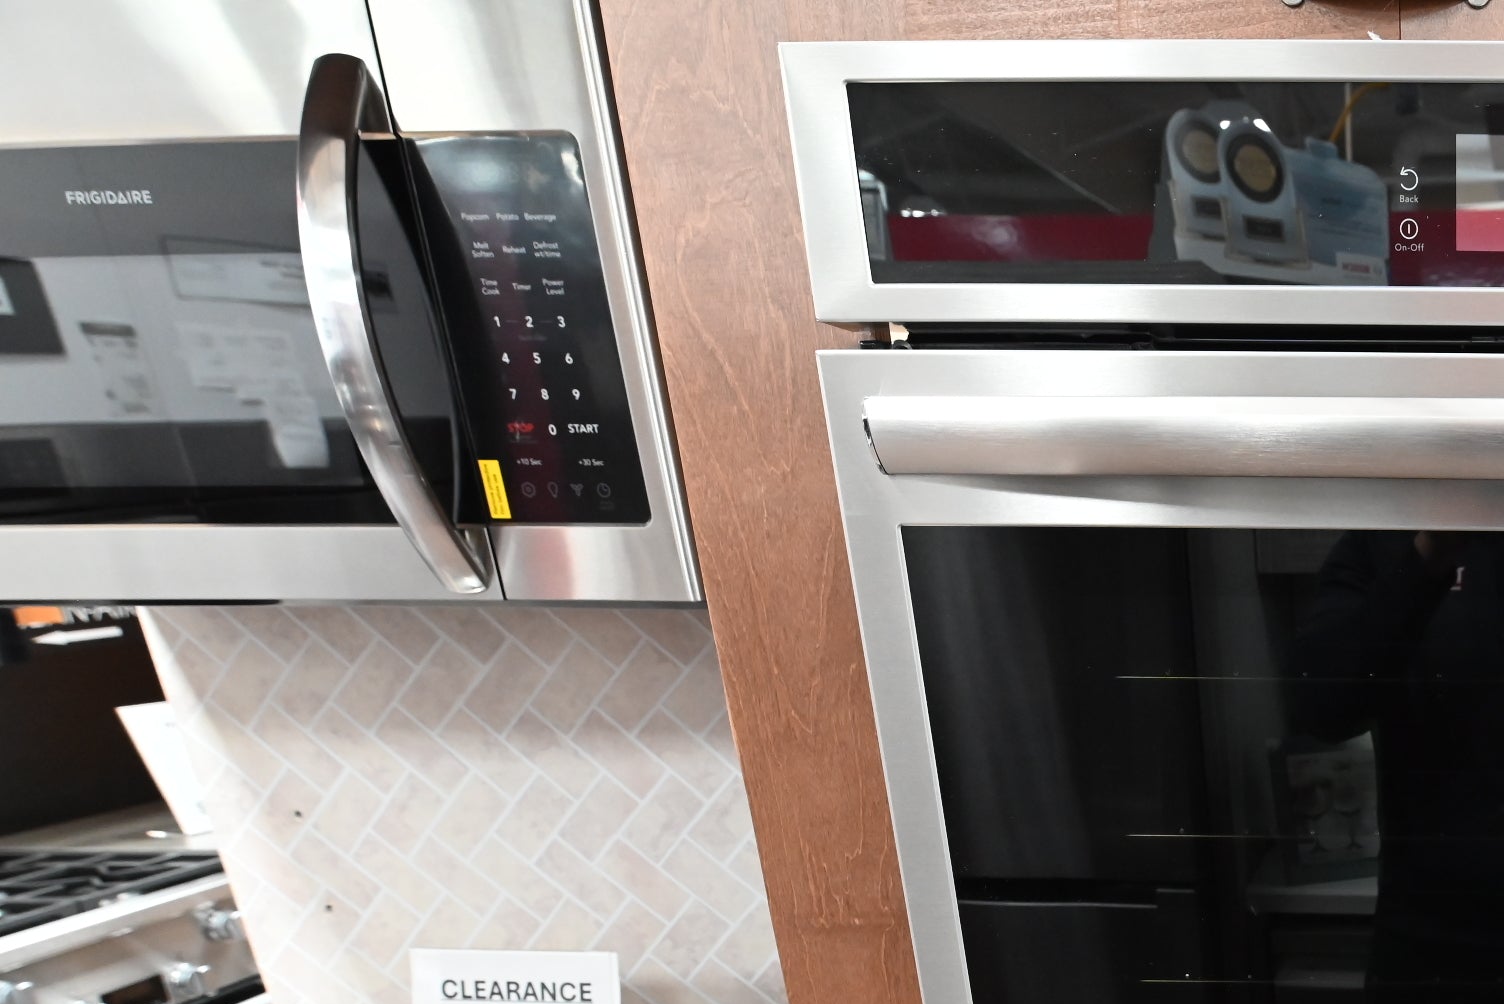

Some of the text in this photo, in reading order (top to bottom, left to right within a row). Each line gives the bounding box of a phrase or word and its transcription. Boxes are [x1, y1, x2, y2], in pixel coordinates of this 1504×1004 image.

[64, 190, 153, 205] FRIGIDAIRE
[1399, 194, 1419, 203] Back
[461, 212, 490, 223] Popcorn
[495, 212, 520, 222] Potato
[523, 212, 557, 223] Beverage
[473, 241, 489, 250] Melt
[502, 245, 527, 254] Reheat
[532, 241, 559, 250] Defrost
[1394, 243, 1425, 252] On-Off
[472, 250, 495, 259] Soften
[480, 278, 498, 286] Time
[512, 282, 532, 291] Timer
[541, 278, 564, 286] Power
[482, 287, 500, 296] Cook
[545, 287, 565, 296] Level
[493, 315, 566, 328] 1 2 3
[501, 352, 574, 365] 4 5 6
[508, 388, 581, 401] 7 8 9
[507, 422, 534, 433] STOP
[548, 423, 557, 436] 0
[567, 423, 600, 434] START
[529, 458, 542, 466] Sec
[592, 459, 605, 467] Sec
[441, 978, 593, 1003] CLEARANCE
